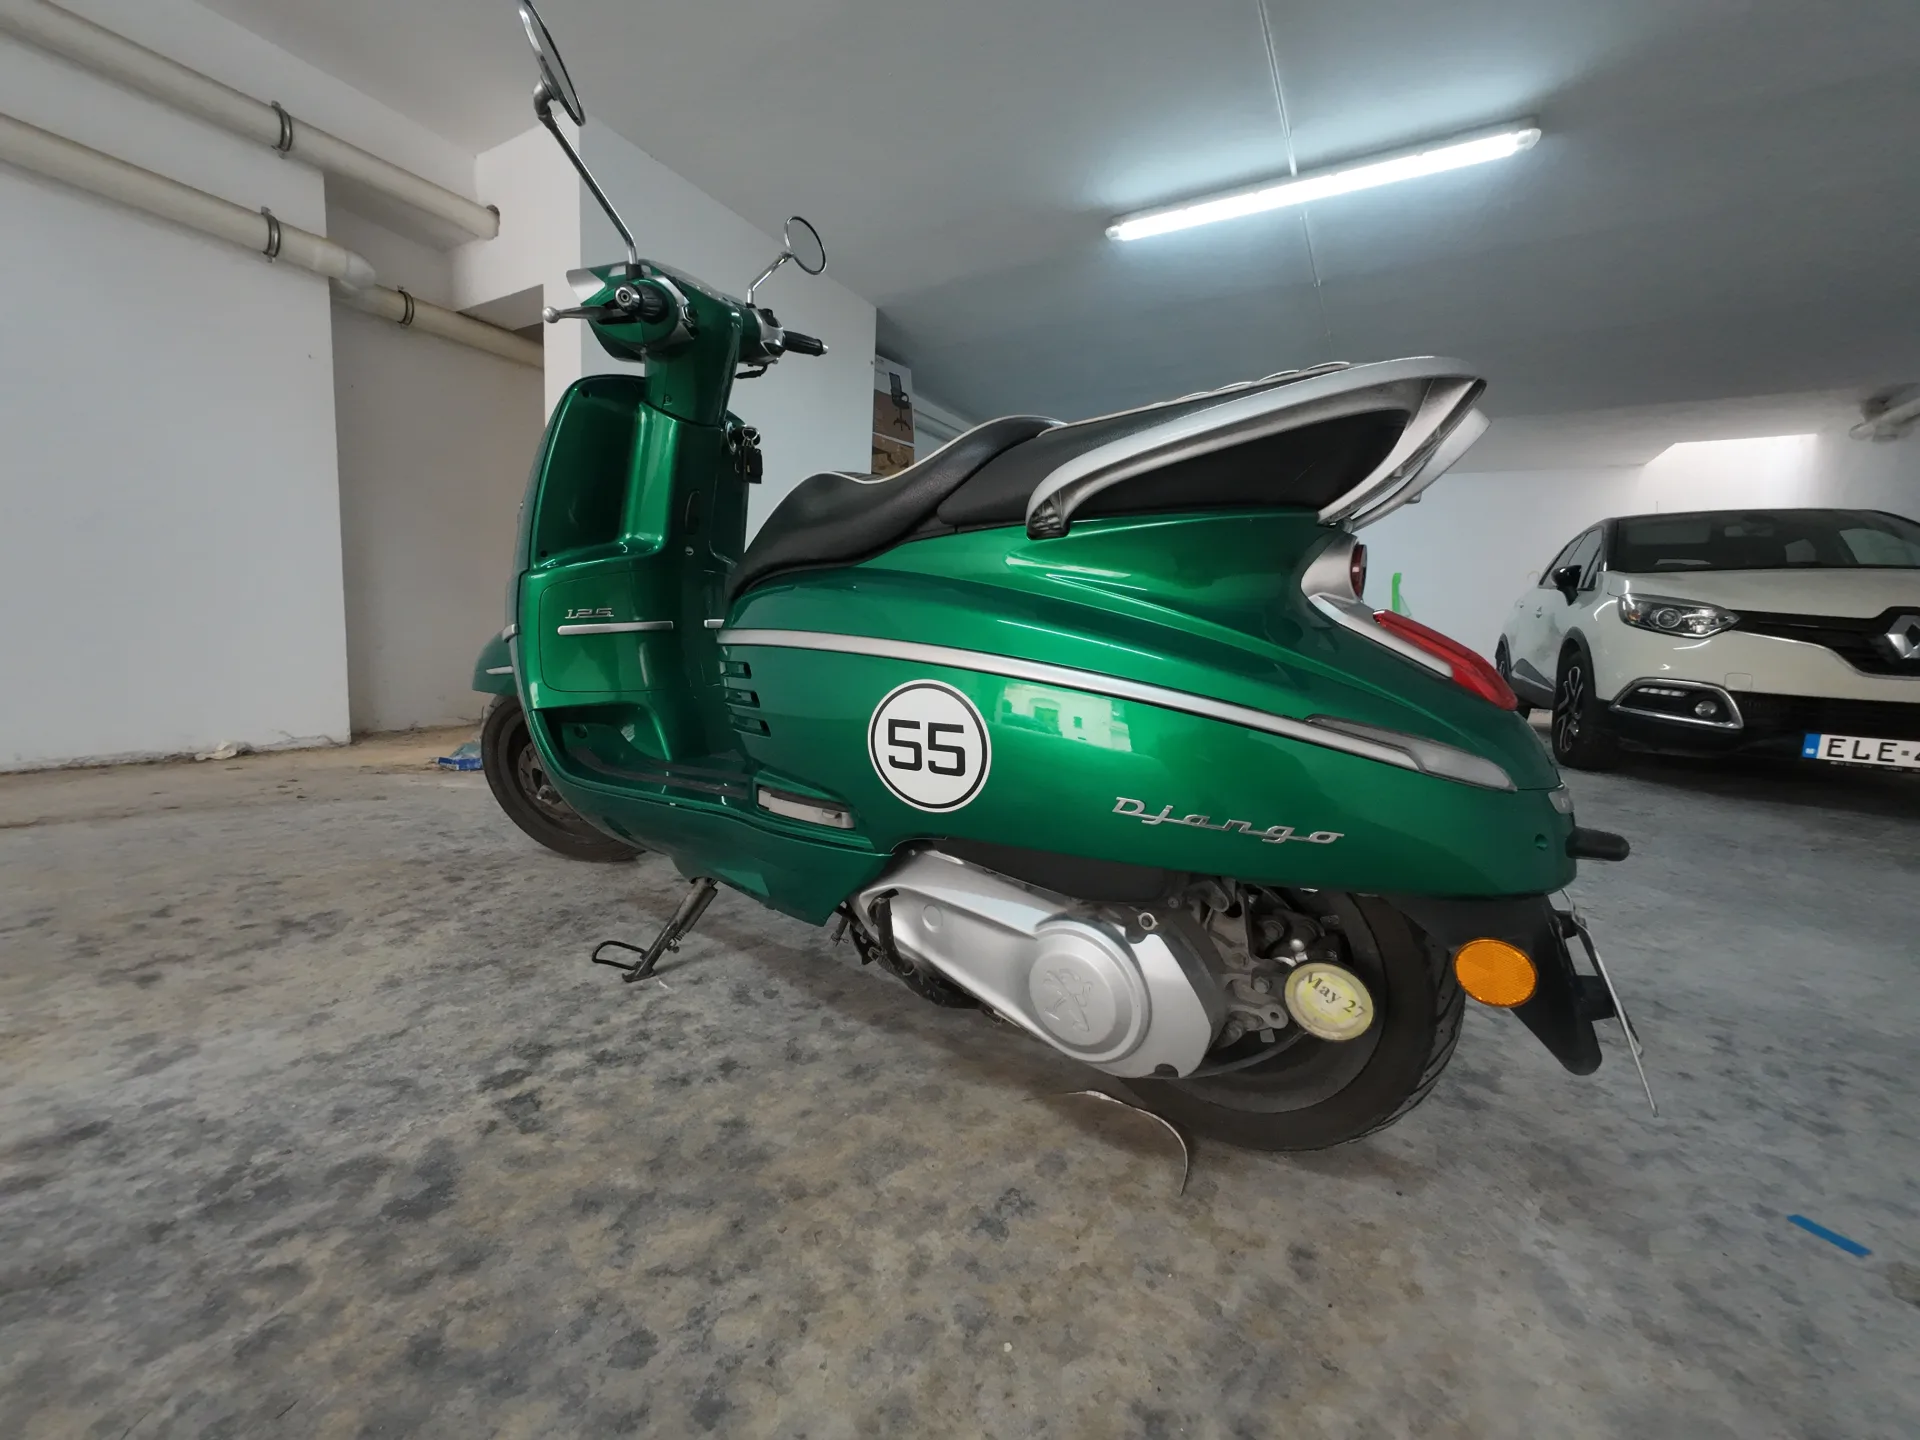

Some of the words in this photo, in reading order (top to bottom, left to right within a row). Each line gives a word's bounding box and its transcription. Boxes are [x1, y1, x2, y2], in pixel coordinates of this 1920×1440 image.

[565, 607, 614, 619] 125
[888, 718, 966, 777] 55
[1112, 796, 1345, 844] Django
[1304, 971, 1342, 1004] May
[1343, 999, 1367, 1019] 27
